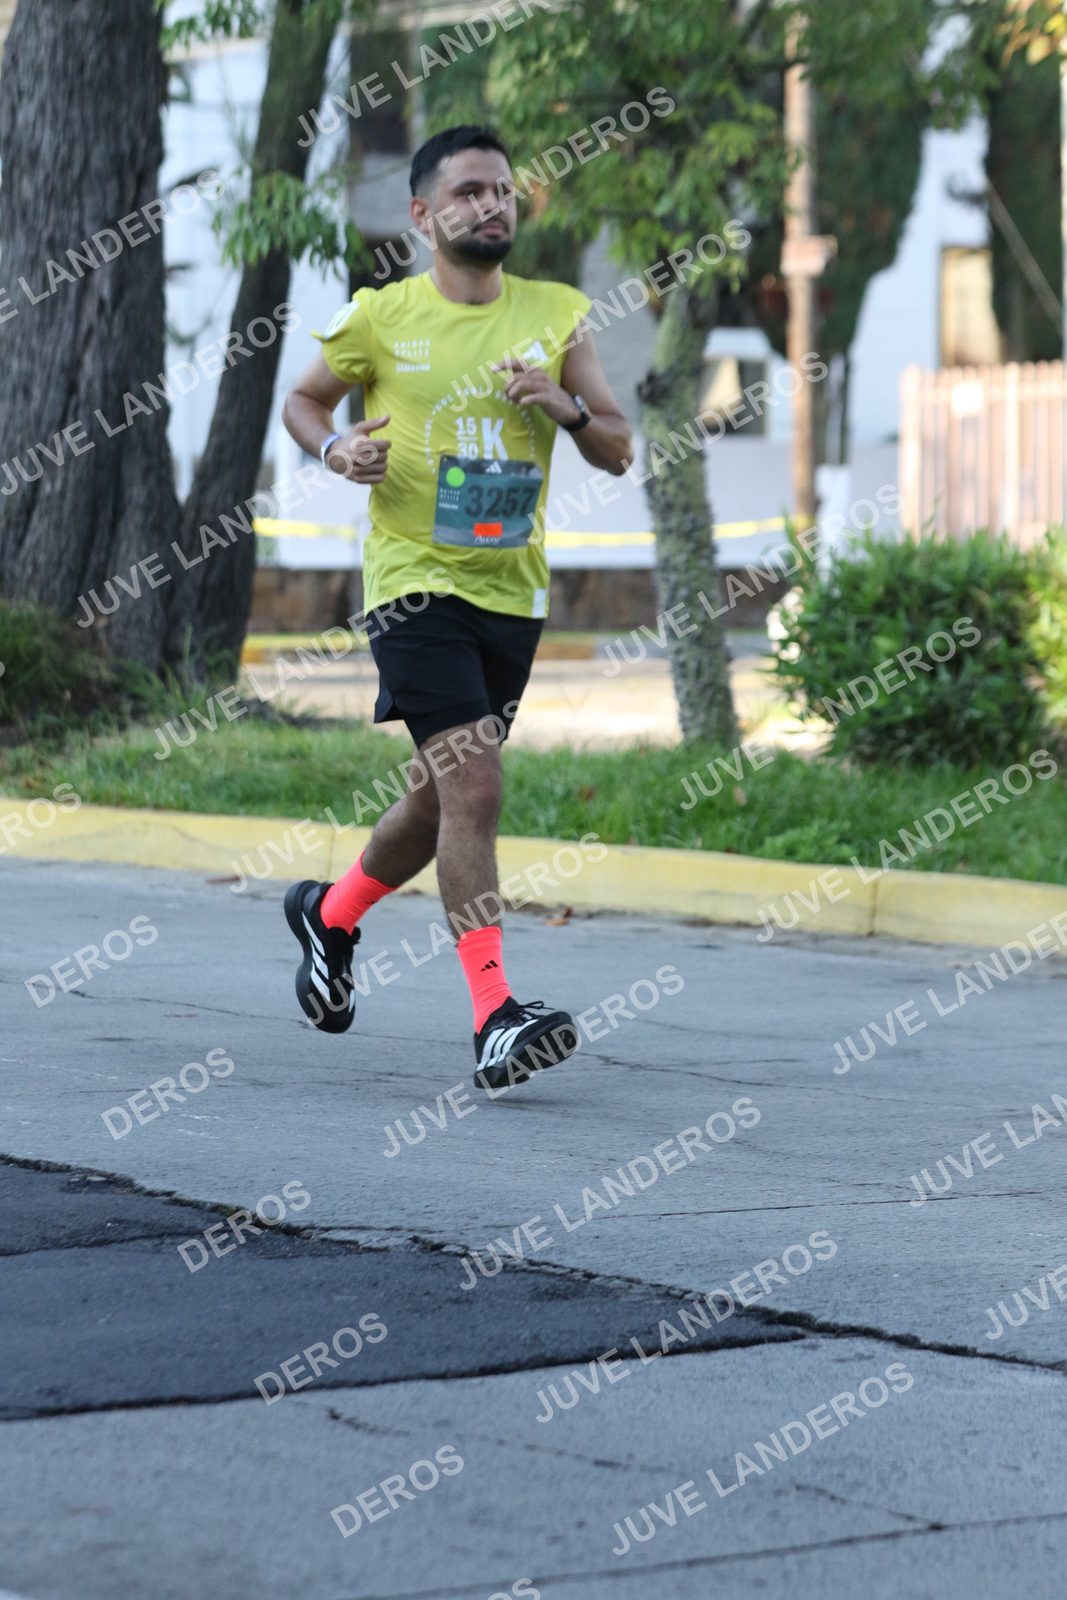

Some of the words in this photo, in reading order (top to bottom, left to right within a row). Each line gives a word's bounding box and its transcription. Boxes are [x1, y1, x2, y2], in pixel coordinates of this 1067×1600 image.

[456, 416, 477, 436] 15
[482, 417, 509, 460] K
[464, 484, 536, 519] 3257
